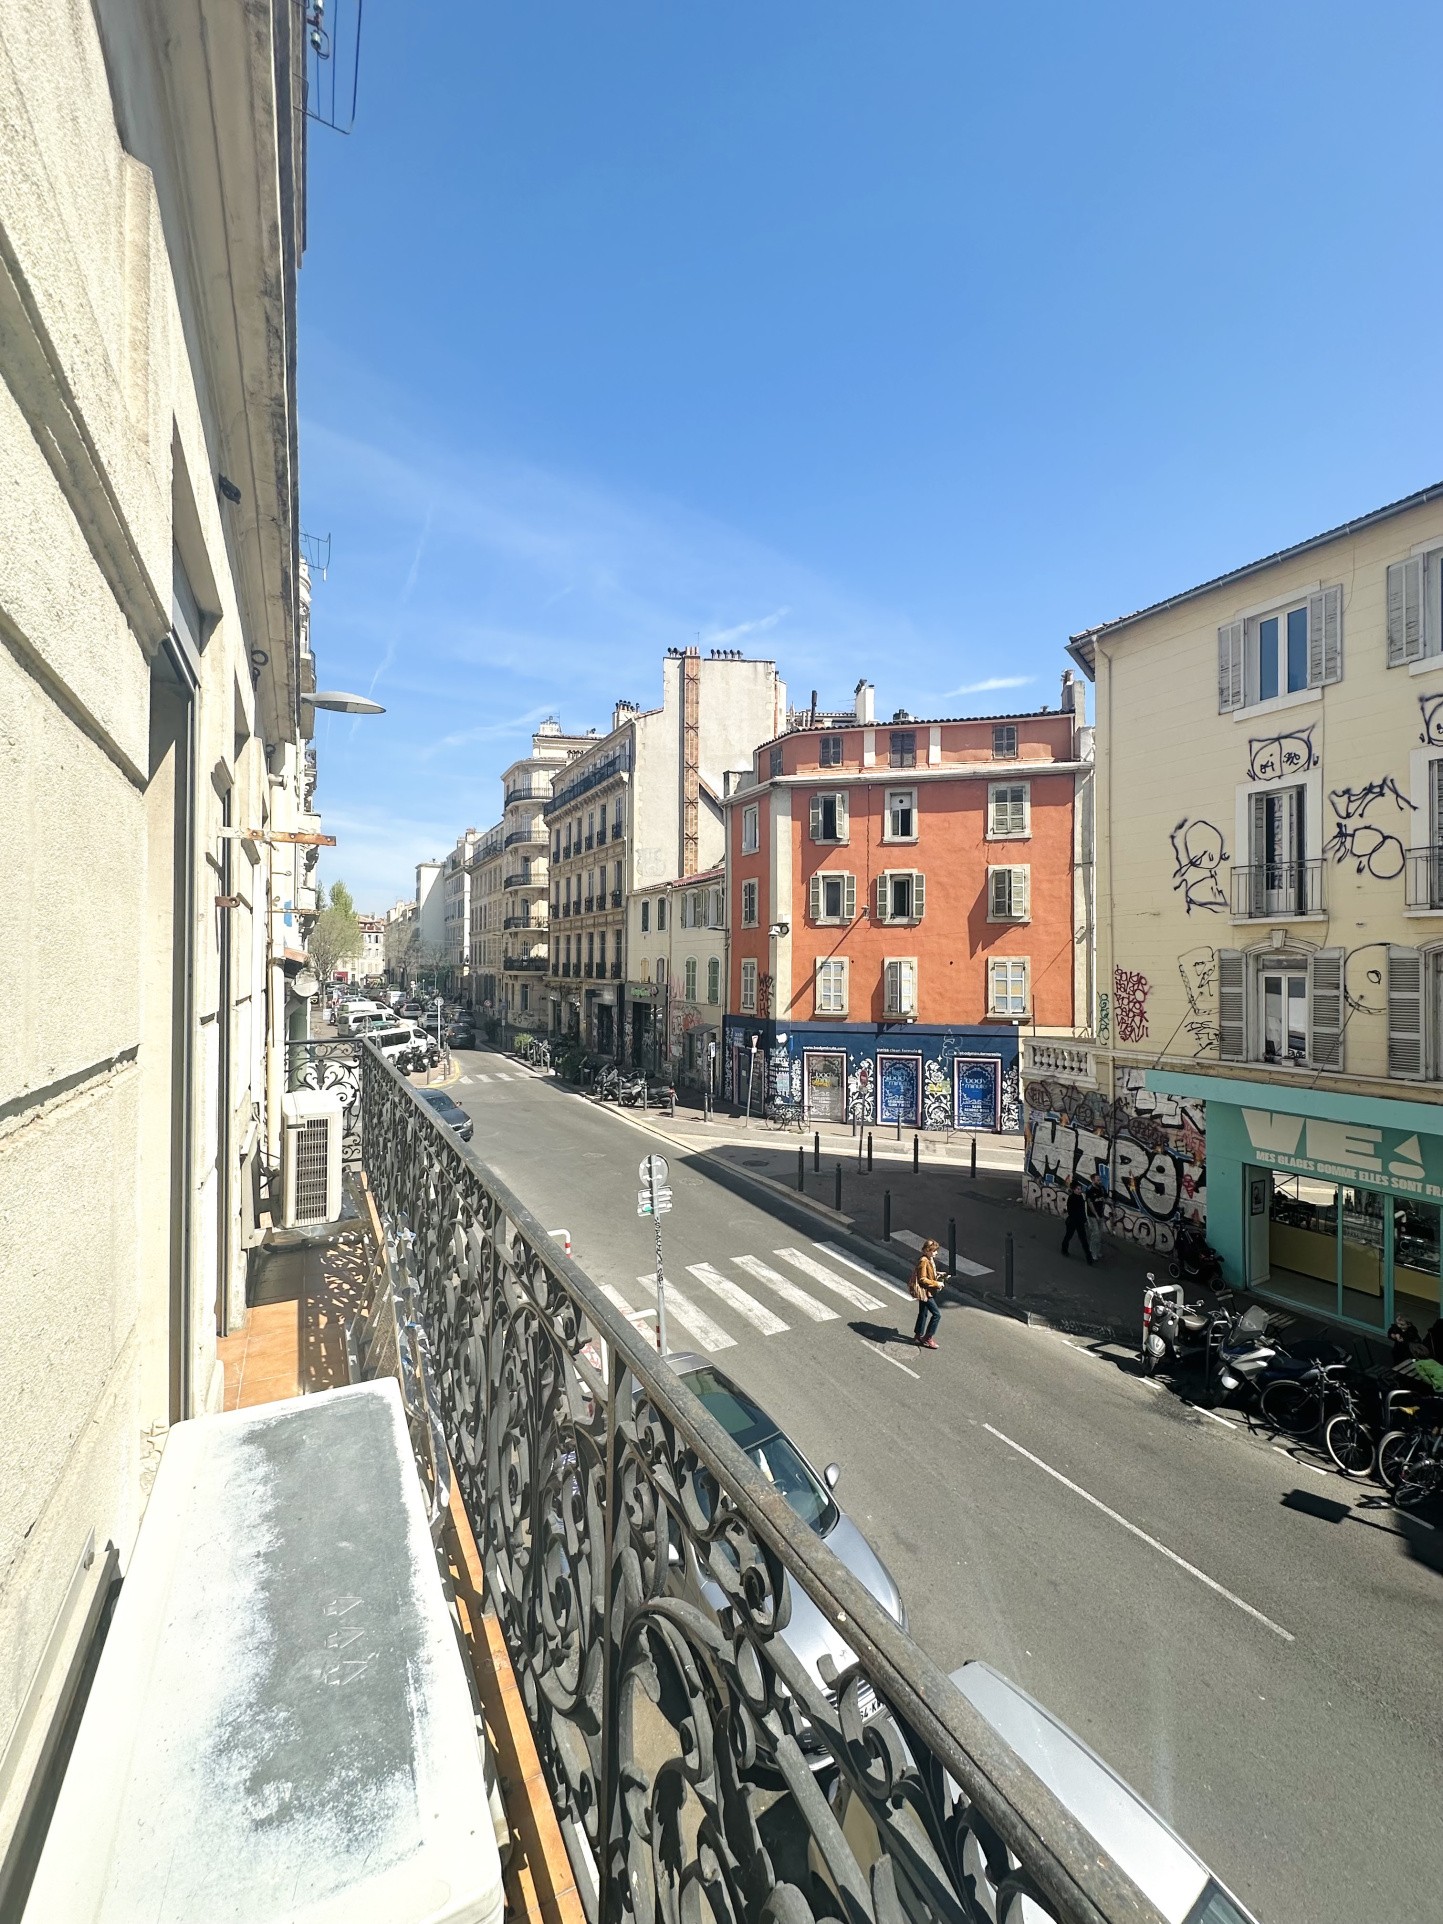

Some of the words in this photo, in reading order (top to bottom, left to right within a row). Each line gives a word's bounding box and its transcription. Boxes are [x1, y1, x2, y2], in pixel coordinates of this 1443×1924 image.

[1256, 1150, 1276, 1163] MES
[1277, 1154, 1315, 1171] GLACES
[1317, 1162, 1357, 1180] COMME
[1358, 1168, 1389, 1187] ELLES
[1391, 1177, 1423, 1193] SONT
[1425, 1184, 1443, 1198] FR
